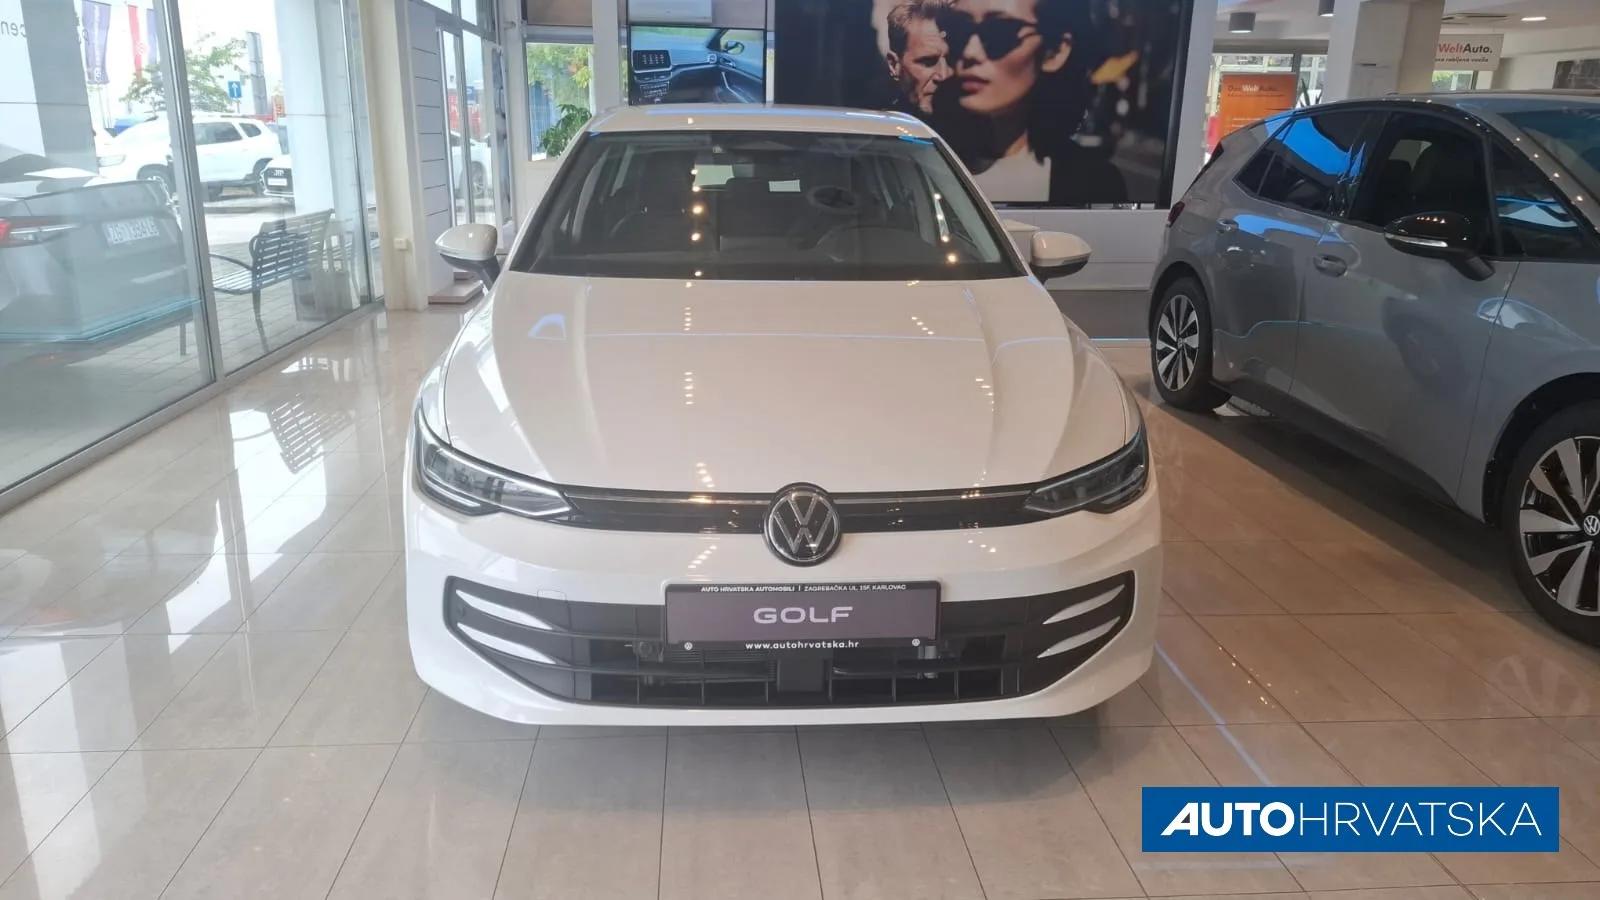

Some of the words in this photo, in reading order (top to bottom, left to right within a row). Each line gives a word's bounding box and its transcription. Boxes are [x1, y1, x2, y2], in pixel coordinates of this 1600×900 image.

[1438, 43, 1493, 54] WeltAuto.
[755, 585, 795, 593] AUTOMOBILI
[804, 584, 848, 592] ZAGREBAČKA
[753, 606, 853, 624] GOLF
[745, 640, 860, 650] www.autohrvatska.hr
